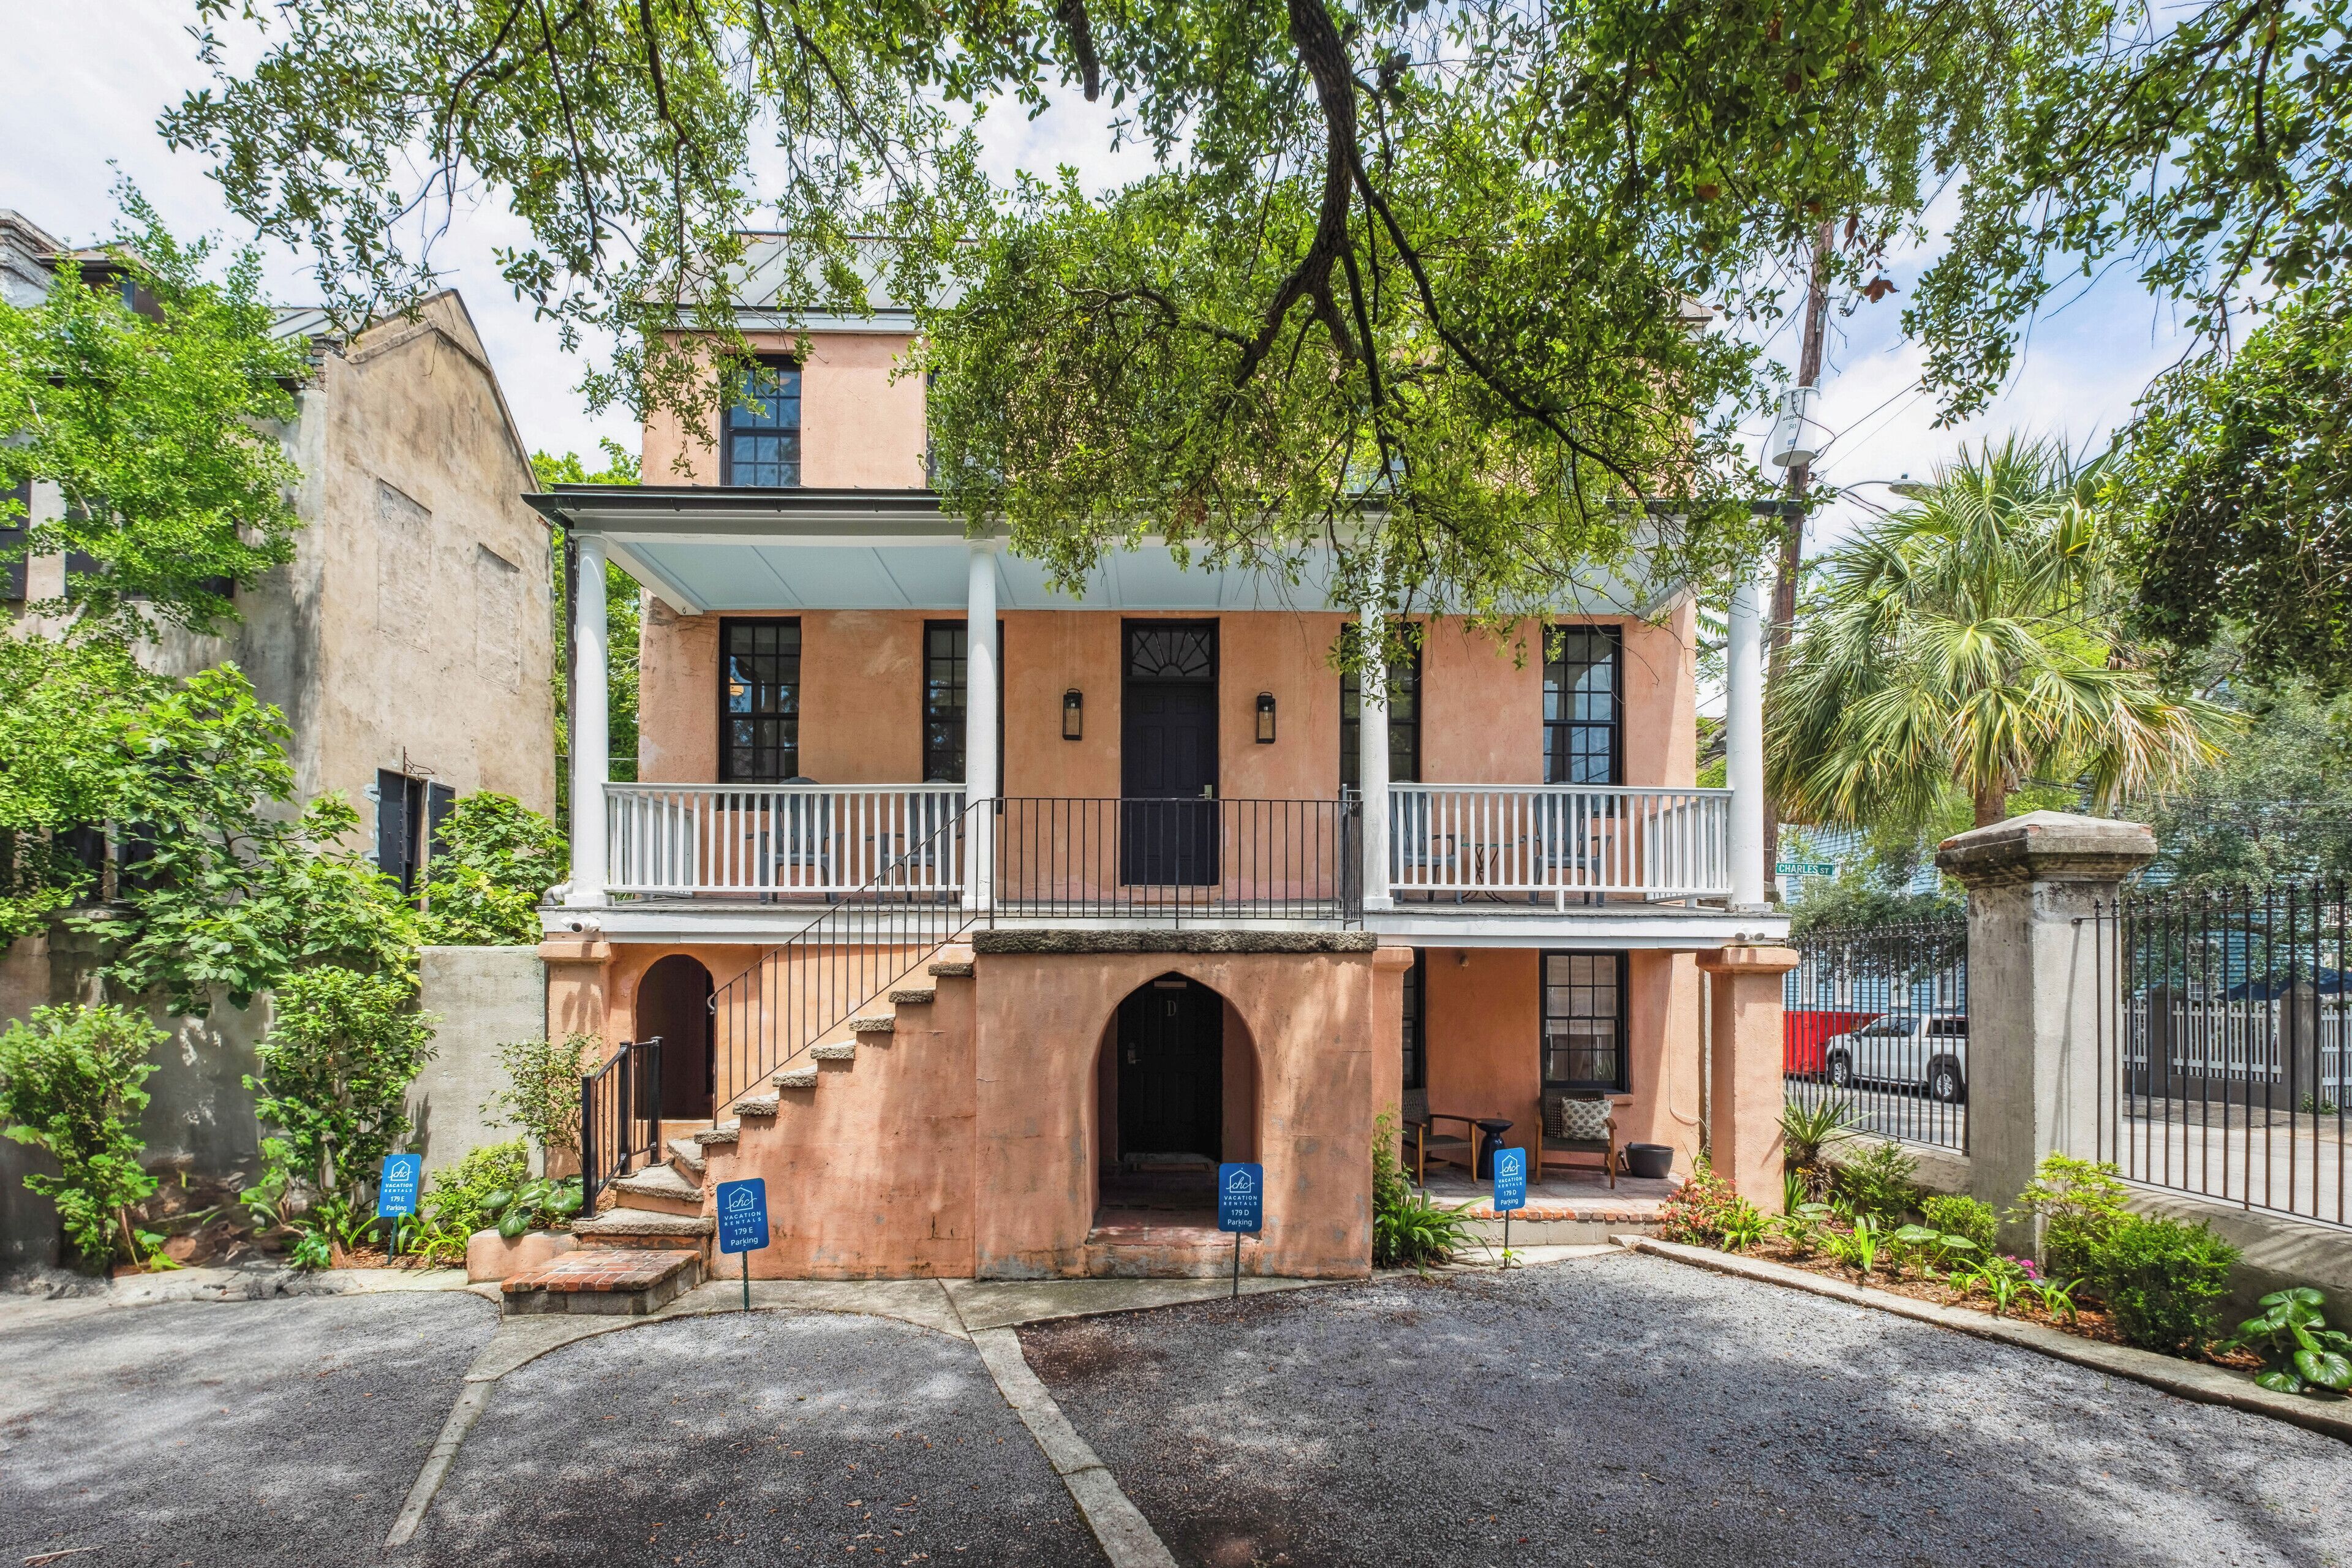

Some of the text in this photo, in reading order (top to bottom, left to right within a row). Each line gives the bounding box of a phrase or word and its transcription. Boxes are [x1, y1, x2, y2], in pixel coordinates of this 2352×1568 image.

[1779, 864, 1819, 873] CHARLES
[1167, 1000, 1176, 1016] D
[725, 1211, 761, 1220] VACATION
[725, 1217, 761, 1226] RENTALS
[731, 1237, 758, 1246] Parking
